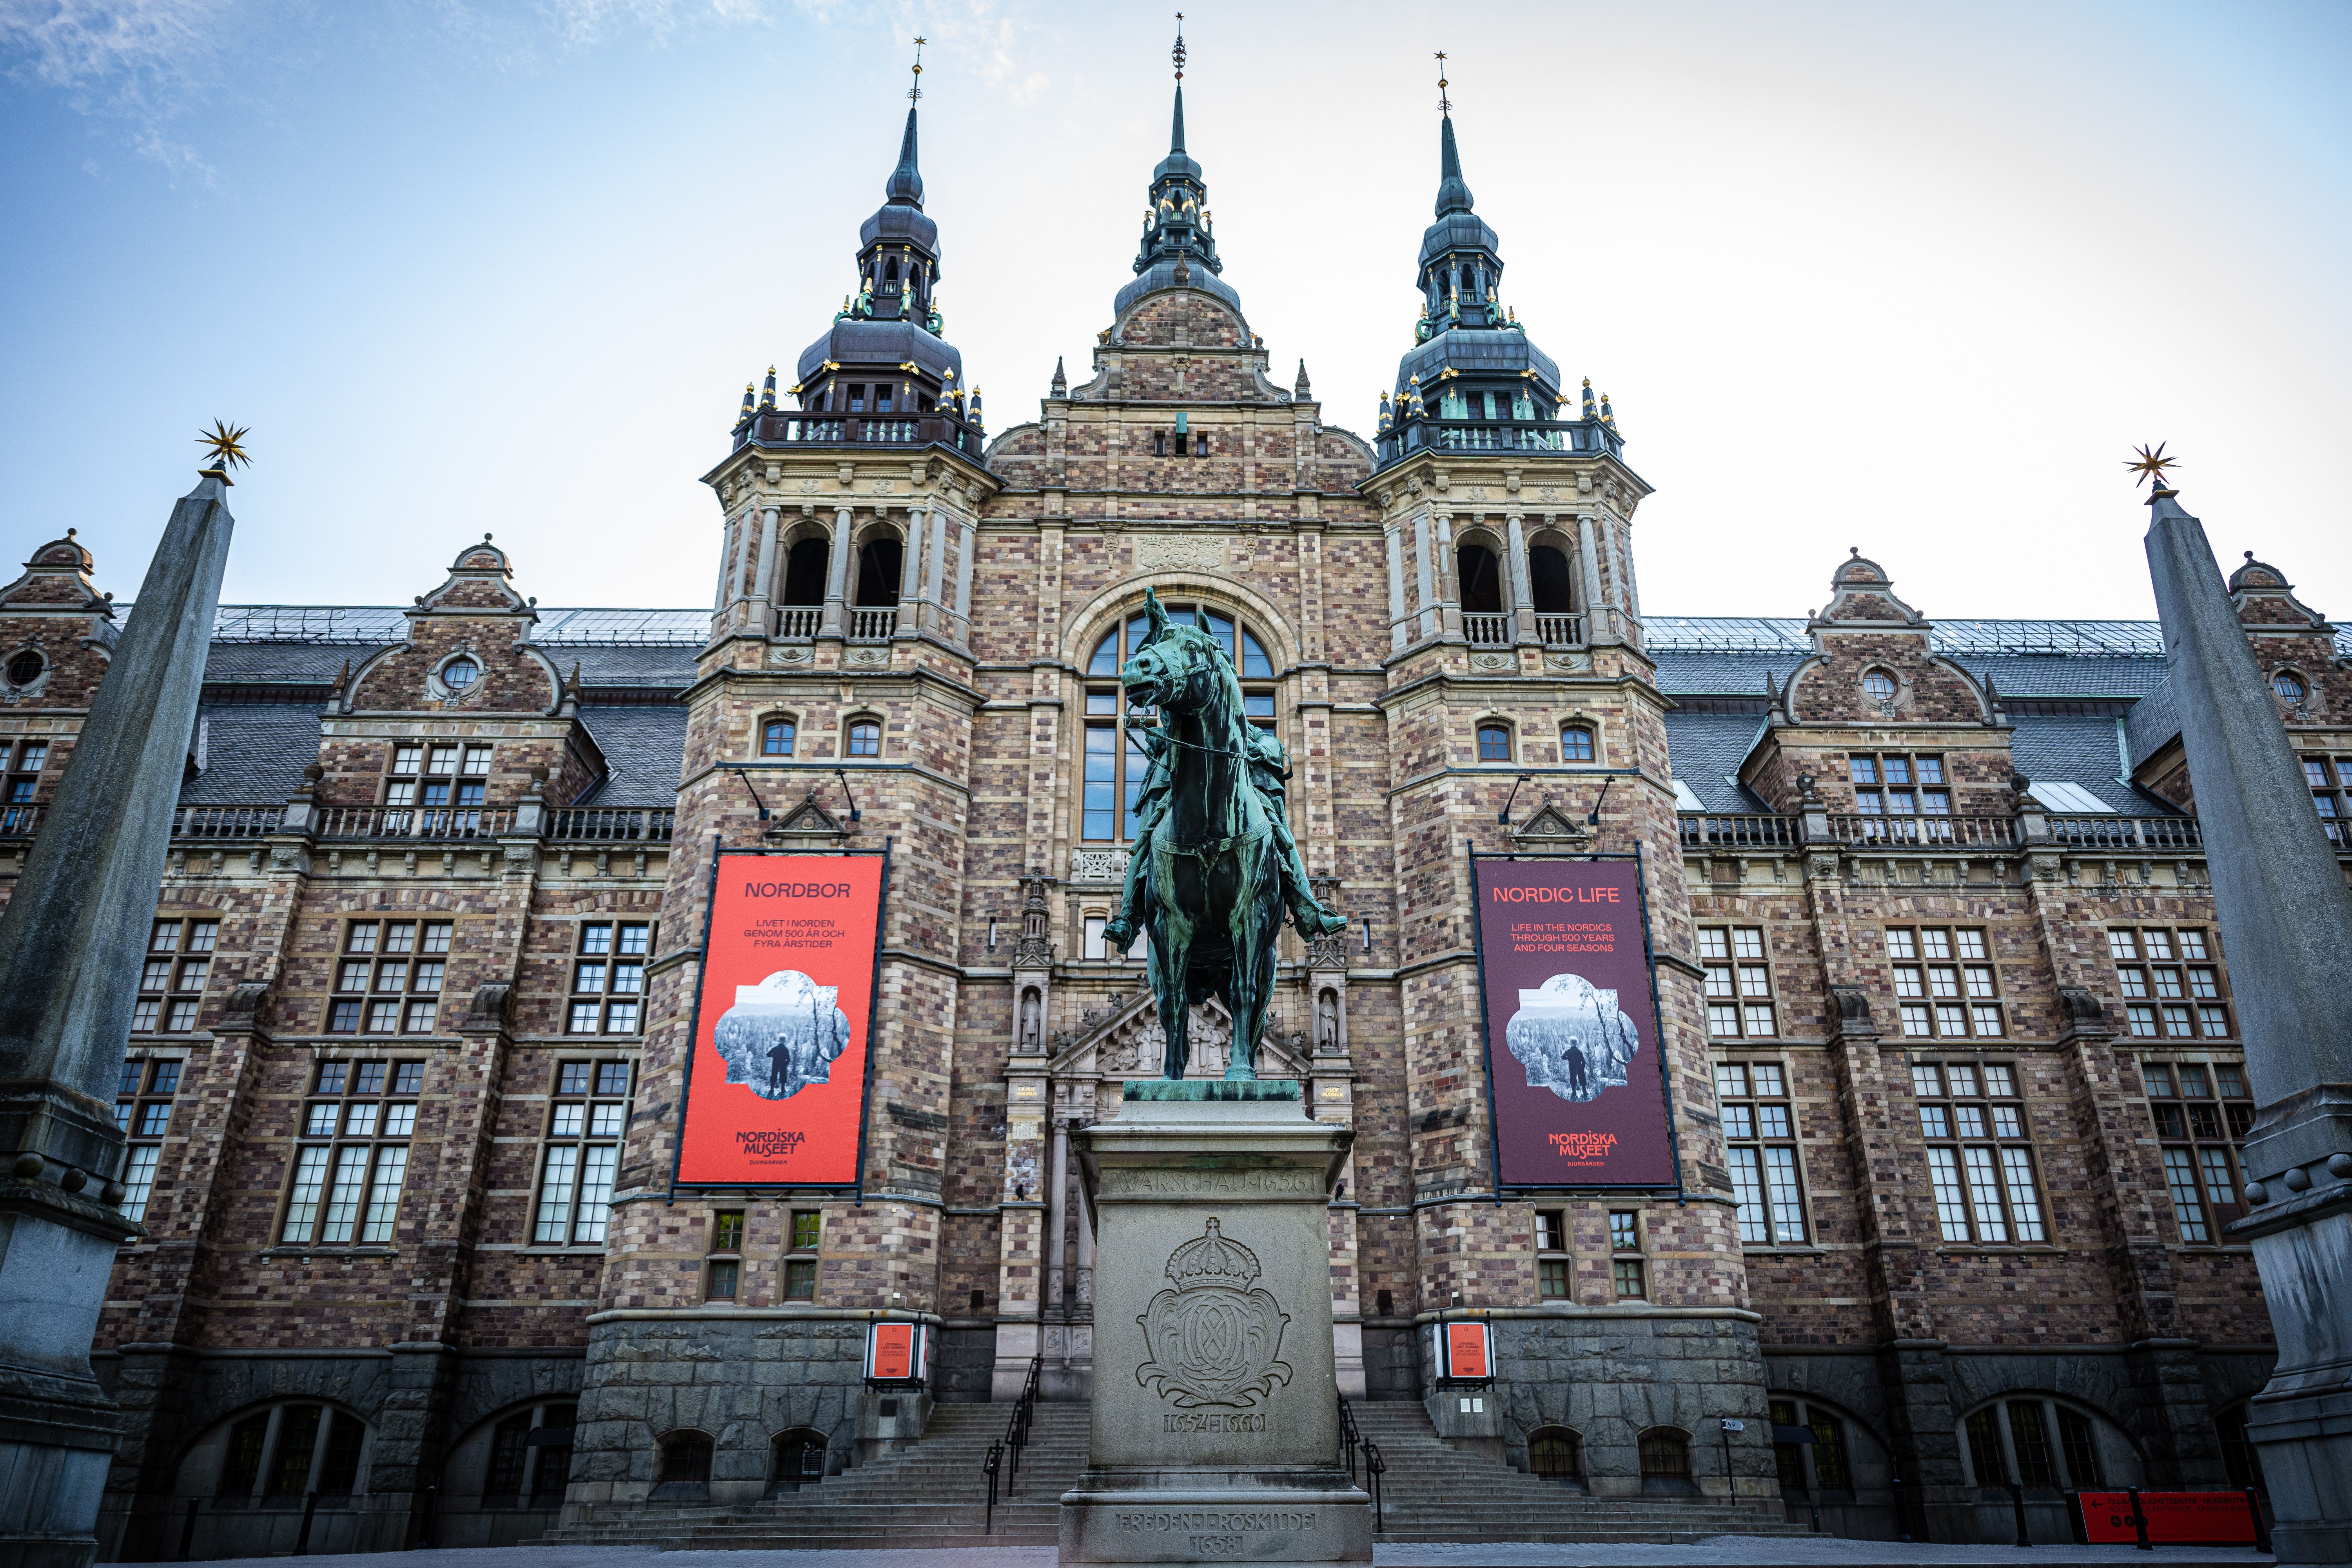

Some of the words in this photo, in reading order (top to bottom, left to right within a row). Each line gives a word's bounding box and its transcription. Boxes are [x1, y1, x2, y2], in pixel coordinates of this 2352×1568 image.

[745, 883, 851, 898] NORDBOR
[1494, 887, 1573, 902] NORDIC
[1578, 887, 1620, 902] LIFE
[806, 928, 820, 937] ÅR
[1567, 924, 1612, 932] NORDICS
[783, 938, 833, 948] ÅRSTIDER
[736, 1128, 806, 1143] NORDISKA
[1549, 1130, 1617, 1145] NORDISKA
[744, 1143, 797, 1158] MUSEET
[1559, 1145, 1610, 1159] MUSEET
[1165, 1414, 1264, 1432] 1654-1660
[1119, 1514, 1192, 1531] FREDEN
[1218, 1513, 1314, 1531] ROSKILDE
[1192, 1536, 1238, 1553] 1658
